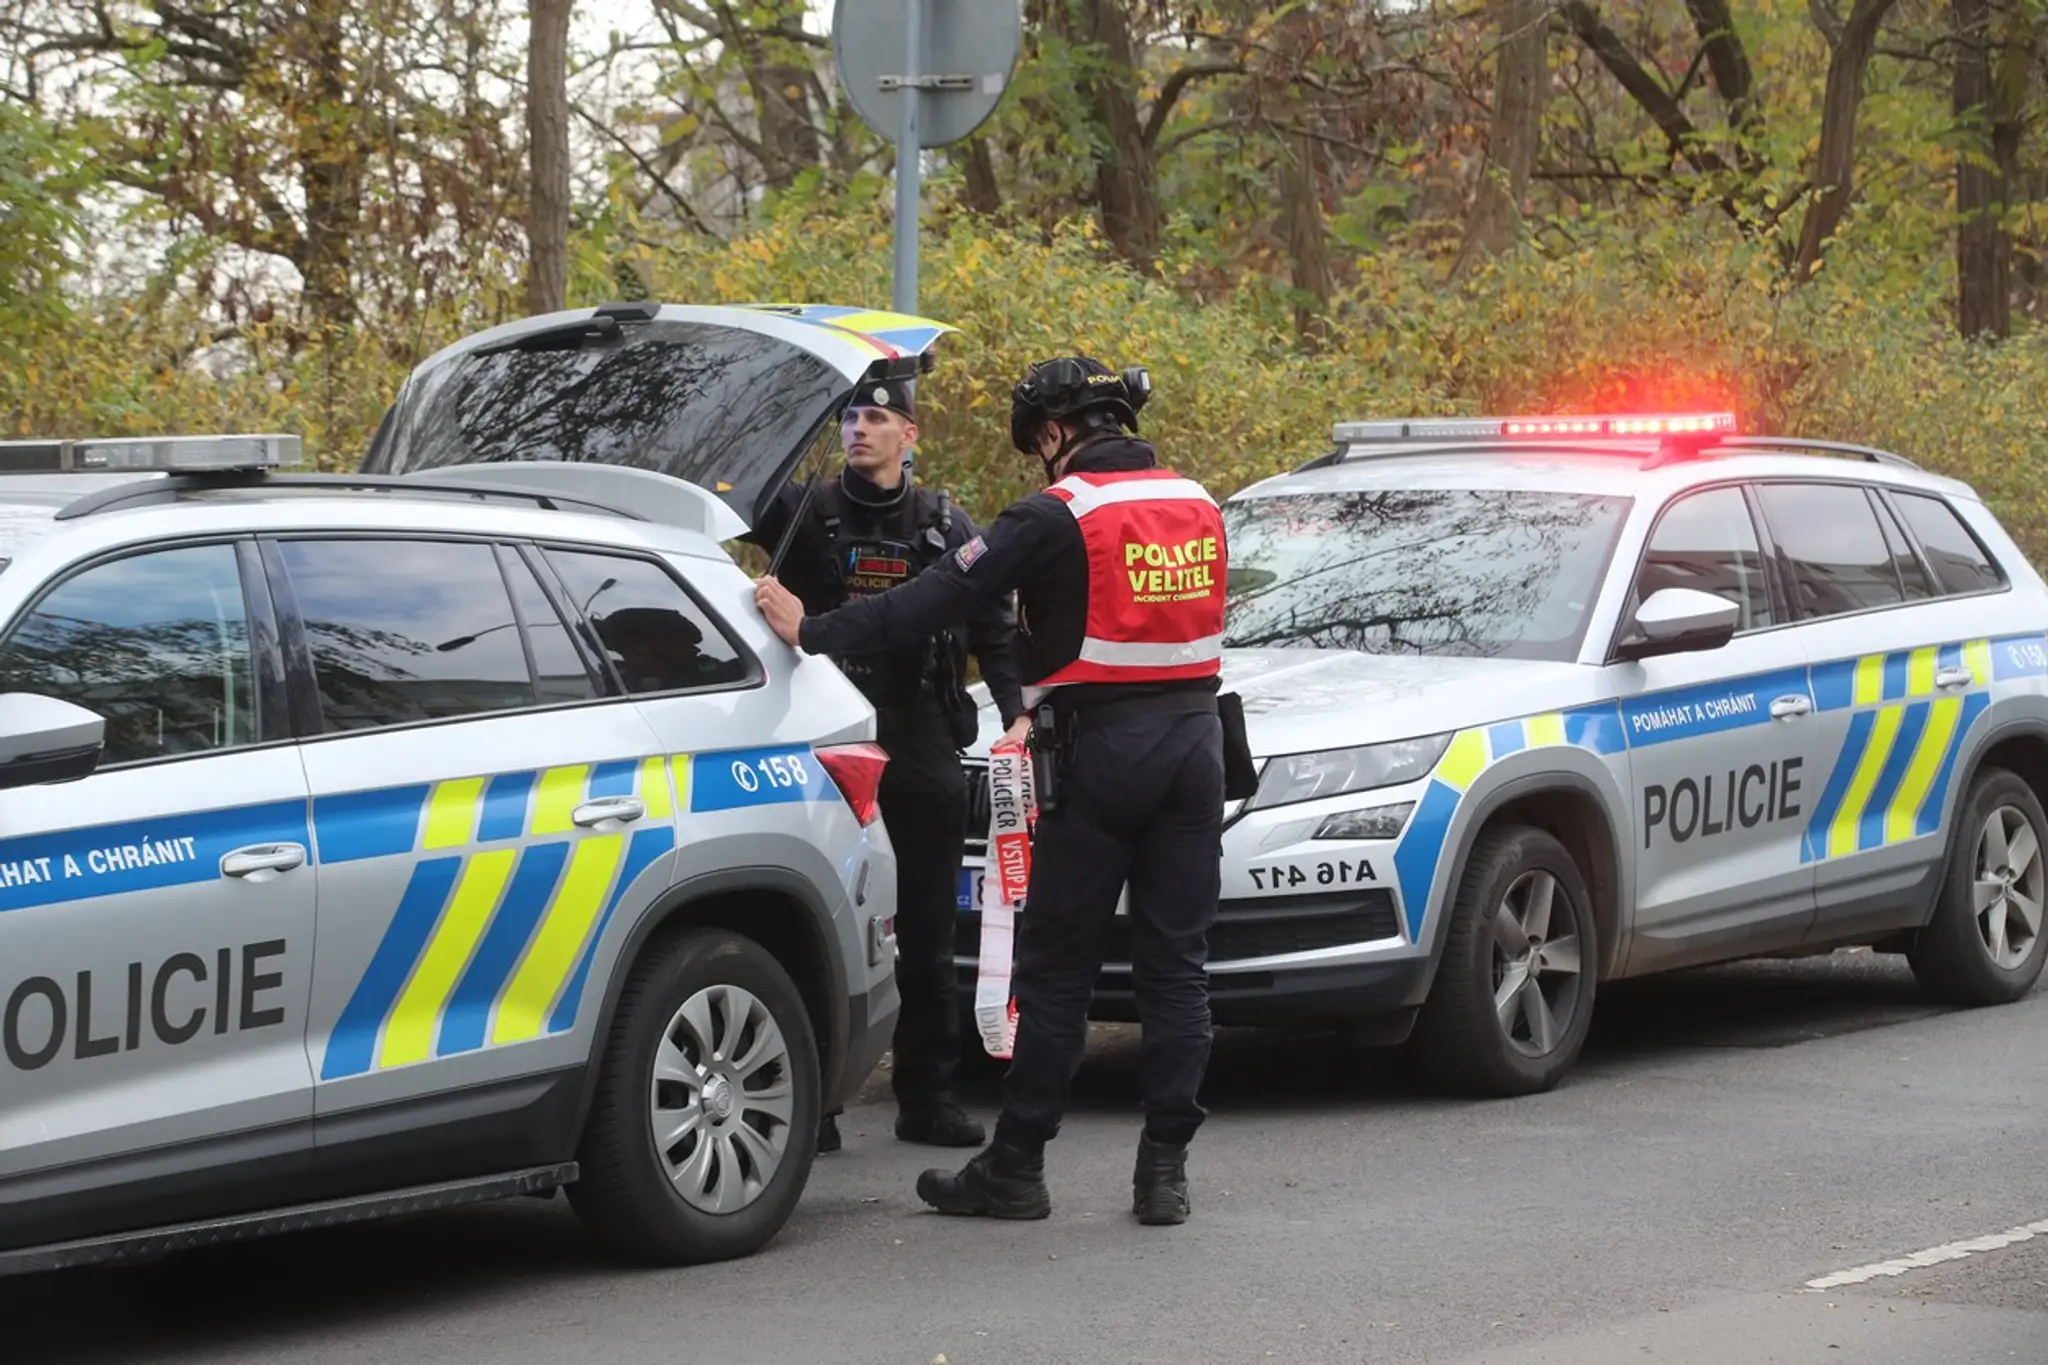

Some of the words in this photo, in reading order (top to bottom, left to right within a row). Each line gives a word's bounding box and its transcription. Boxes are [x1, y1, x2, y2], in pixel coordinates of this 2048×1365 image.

[1125, 537, 1217, 567] POLICIE
[1127, 565, 1215, 592] VELITEL
[1632, 705, 1693, 733] POMÁHAT
[1694, 703, 1706, 722] A
[1705, 691, 1757, 719] CHRÁNIT
[757, 755, 808, 788] 158
[993, 758, 1014, 808] POLICIE
[996, 811, 1020, 829] ČR
[1644, 756, 1803, 850] POLICIE
[63, 853, 83, 878] A
[88, 835, 196, 875] CHRÁNIT
[1002, 839, 1026, 884] VSTUP
[957, 895, 970, 906] CZ
[3, 938, 286, 1071] OLICIE
